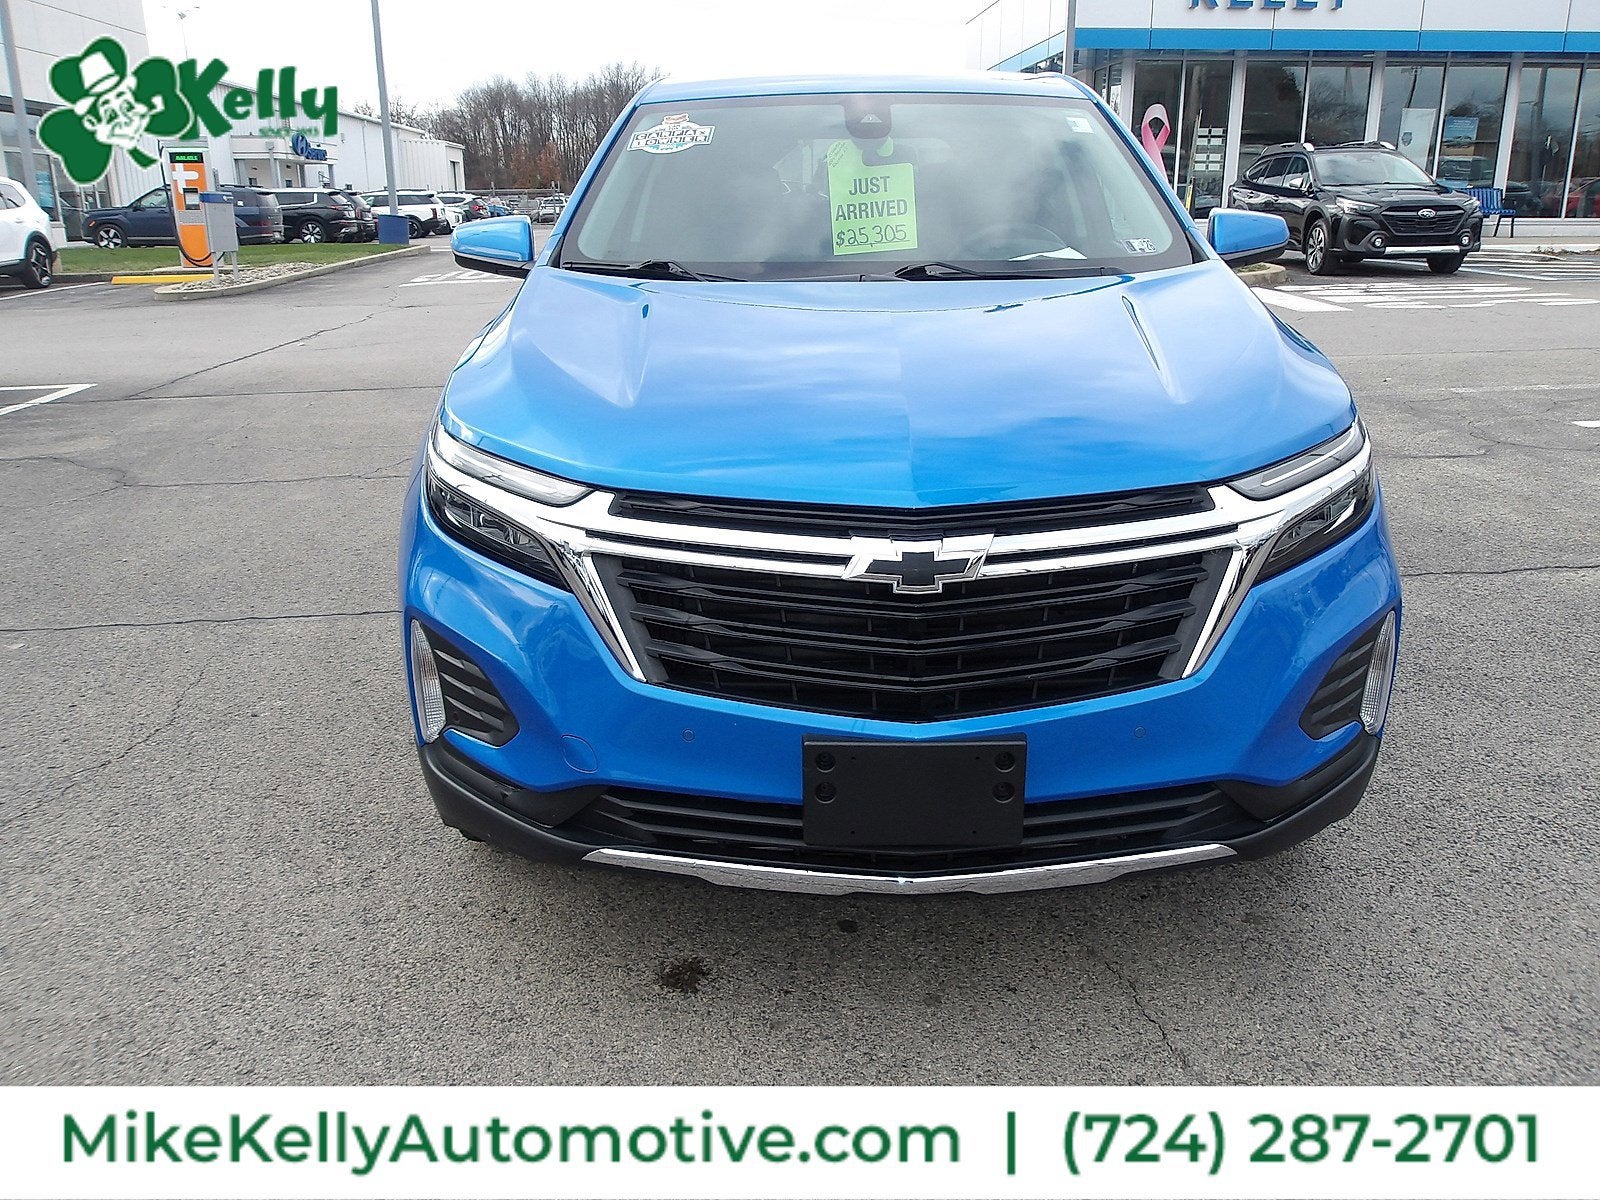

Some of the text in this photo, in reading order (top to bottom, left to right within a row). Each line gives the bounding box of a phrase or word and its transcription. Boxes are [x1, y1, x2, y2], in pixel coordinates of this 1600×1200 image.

[848, 175, 890, 196] JUST
[835, 199, 908, 221] ARRIVED
[836, 224, 907, 248] $25,305
